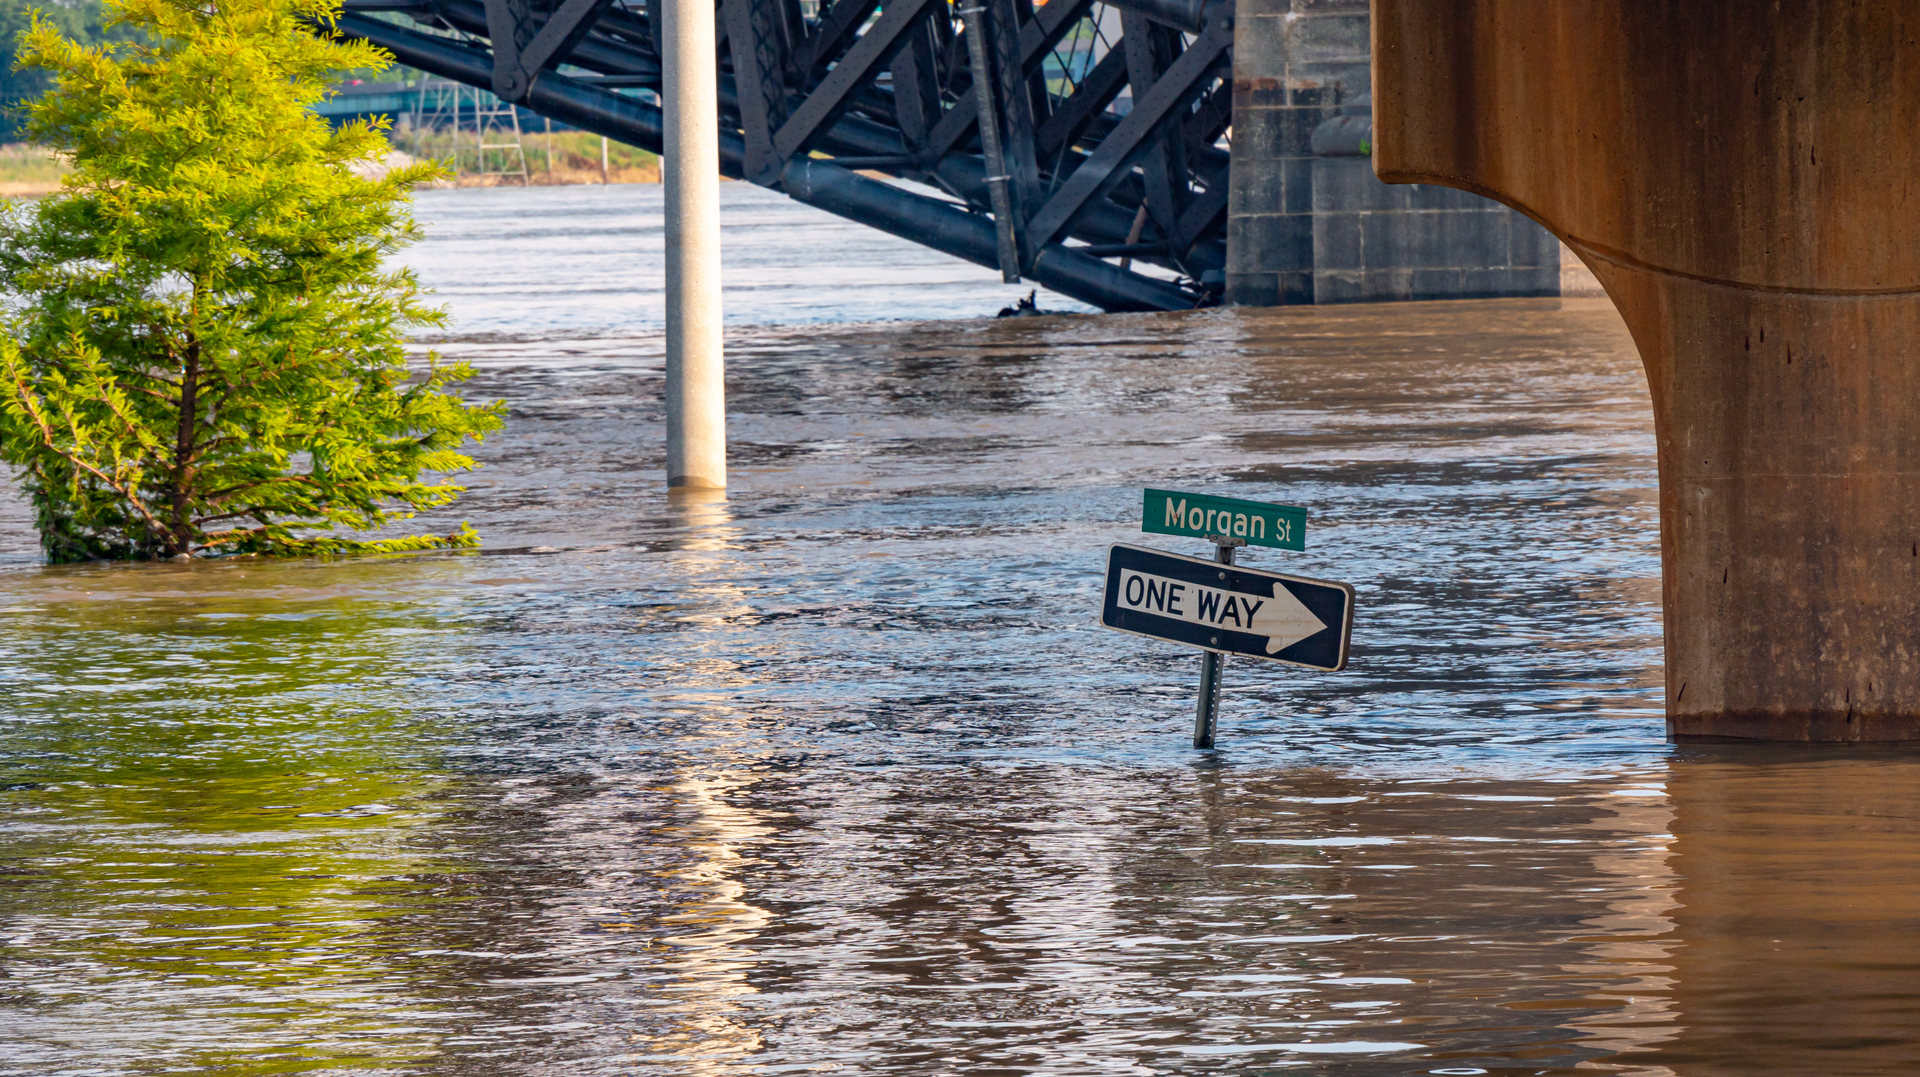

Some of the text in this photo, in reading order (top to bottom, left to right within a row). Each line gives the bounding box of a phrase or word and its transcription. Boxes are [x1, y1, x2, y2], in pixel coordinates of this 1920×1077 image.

[1164, 497, 1292, 543] Morgan St
[1125, 574, 1265, 630] ONE WAY
